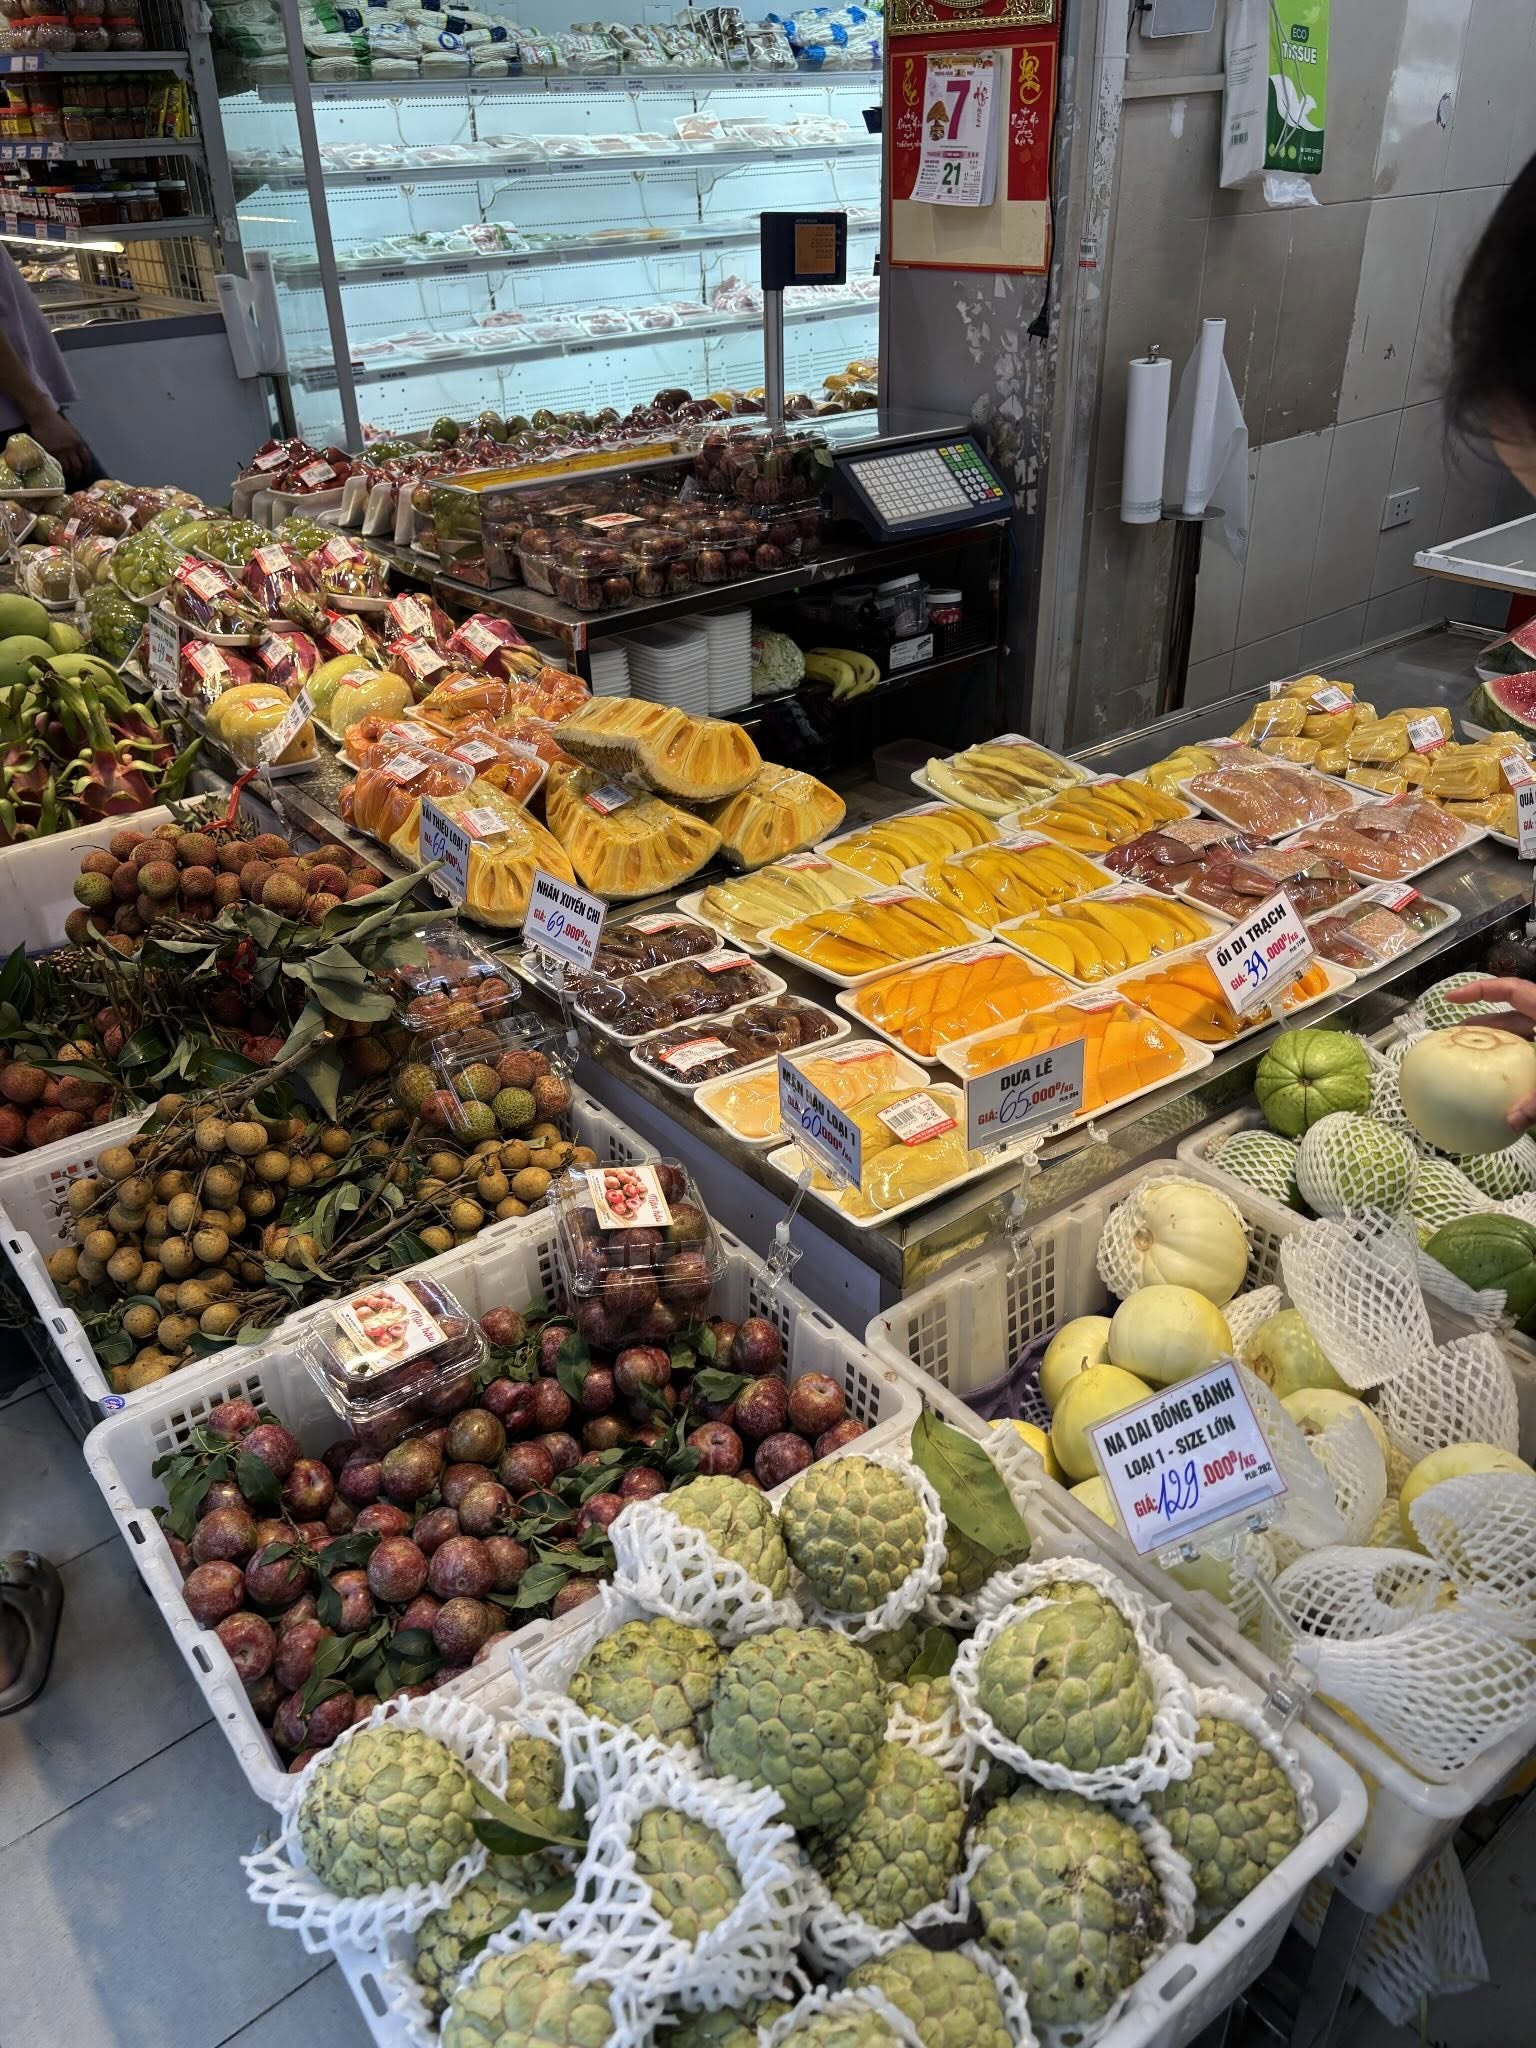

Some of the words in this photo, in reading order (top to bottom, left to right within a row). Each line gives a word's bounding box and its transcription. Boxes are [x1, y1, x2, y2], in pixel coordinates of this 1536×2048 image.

[1292, 27, 1307, 40] ECO
[946, 80, 971, 140] 7
[942, 162, 961, 185] 21
[536, 880, 560, 902] NHÃN
[586, 906, 601, 924] CHI
[1216, 946, 1233, 967] ỔI
[1230, 935, 1248, 956] DI
[1245, 903, 1287, 943] TRẠCH
[1230, 972, 1248, 991] GIÁ:
[1000, 1068, 1031, 1092] DƯA
[1035, 1057, 1053, 1078] LÊ
[826, 1108, 848, 1140] LOẠI
[850, 1132, 856, 1147] 1
[977, 1108, 998, 1126] GIÁ:
[1103, 1431, 1128, 1457] NA
[1125, 1418, 1153, 1447] DAI
[1151, 1399, 1194, 1434] ĐỒNG
[1192, 1377, 1235, 1414] BÀNH
[1124, 1452, 1156, 1480] LOẠI
[1155, 1448, 1165, 1464] 1
[1175, 1428, 1207, 1455] SIZE
[1206, 1414, 1236, 1441] LỚN
[1257, 1461, 1273, 1475] 282
[1133, 1493, 1158, 1518] GIÁ:
